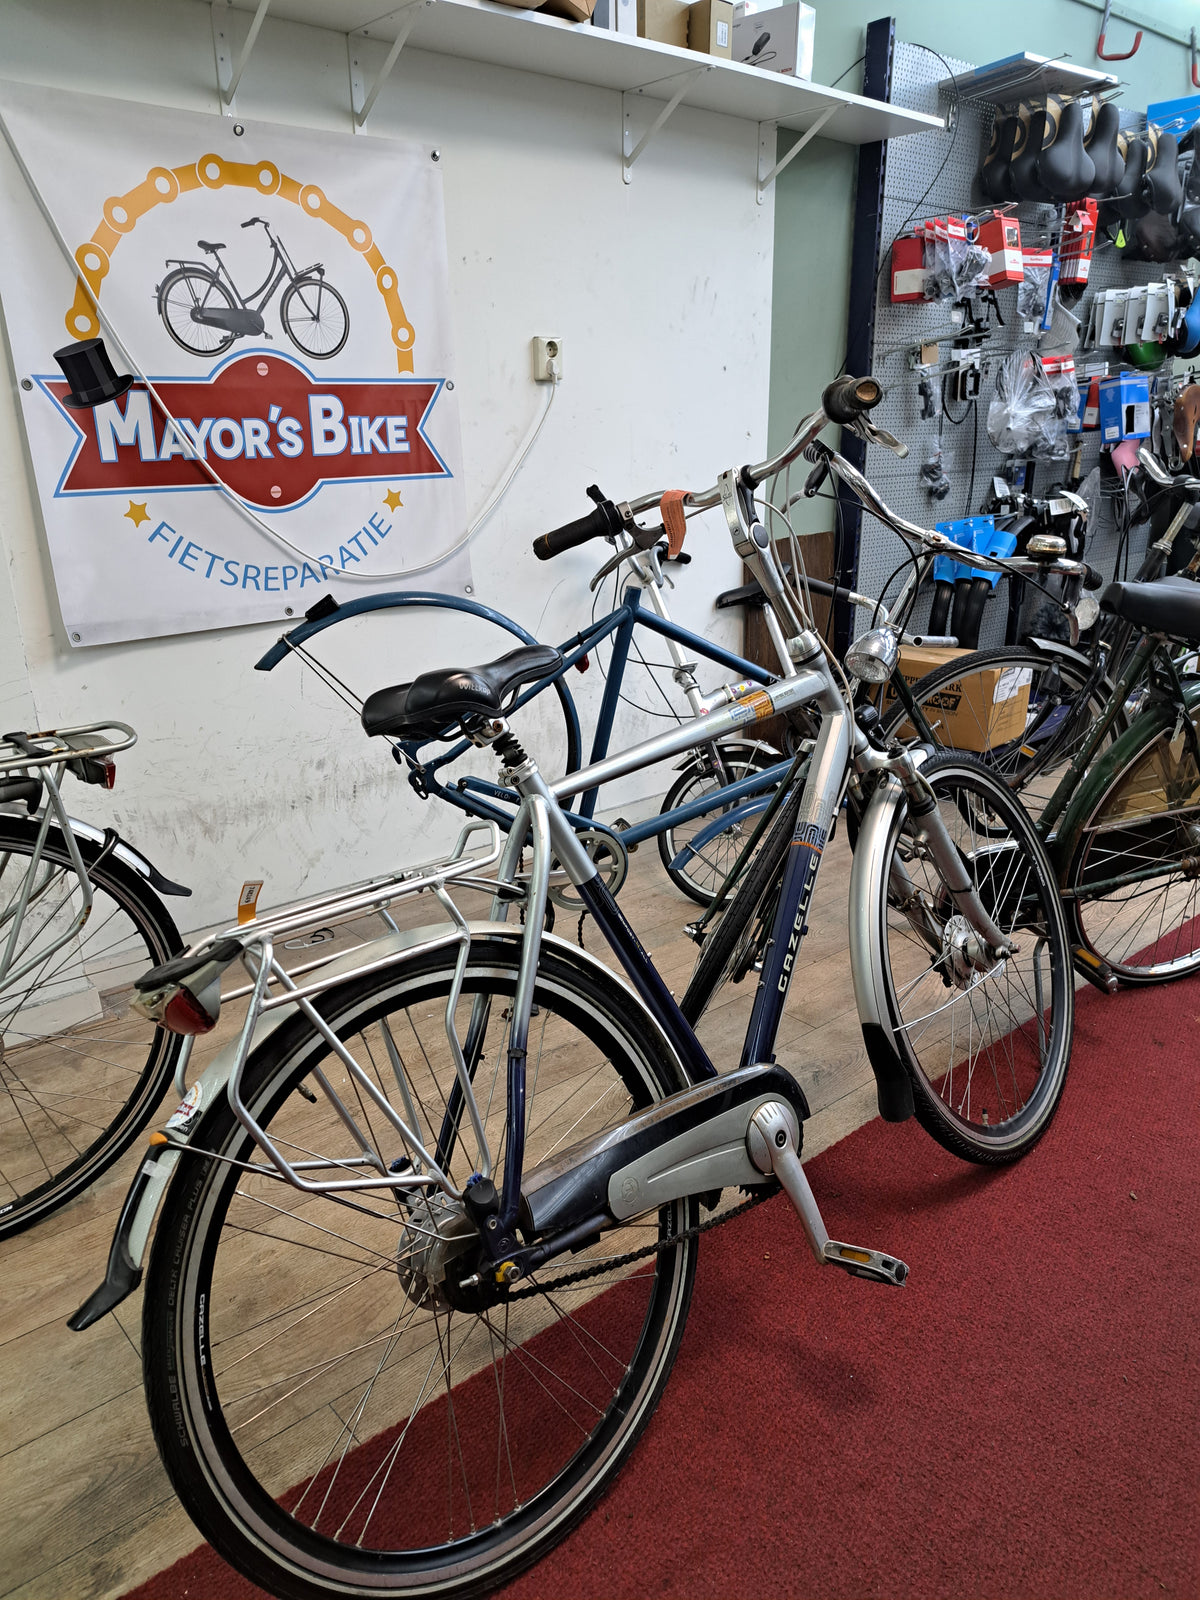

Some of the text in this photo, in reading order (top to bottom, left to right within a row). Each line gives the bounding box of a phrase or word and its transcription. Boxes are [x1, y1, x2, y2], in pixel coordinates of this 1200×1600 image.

[92, 390, 410, 463] MAYOR'S BIKE
[148, 512, 392, 591] FIETSREPARATIE
[778, 853, 819, 993] GAZELLE
[168, 1375, 190, 1449] SCHWALBE
[186, 1179, 203, 1212] PLUS
[198, 1293, 207, 1367] GAZELLE
